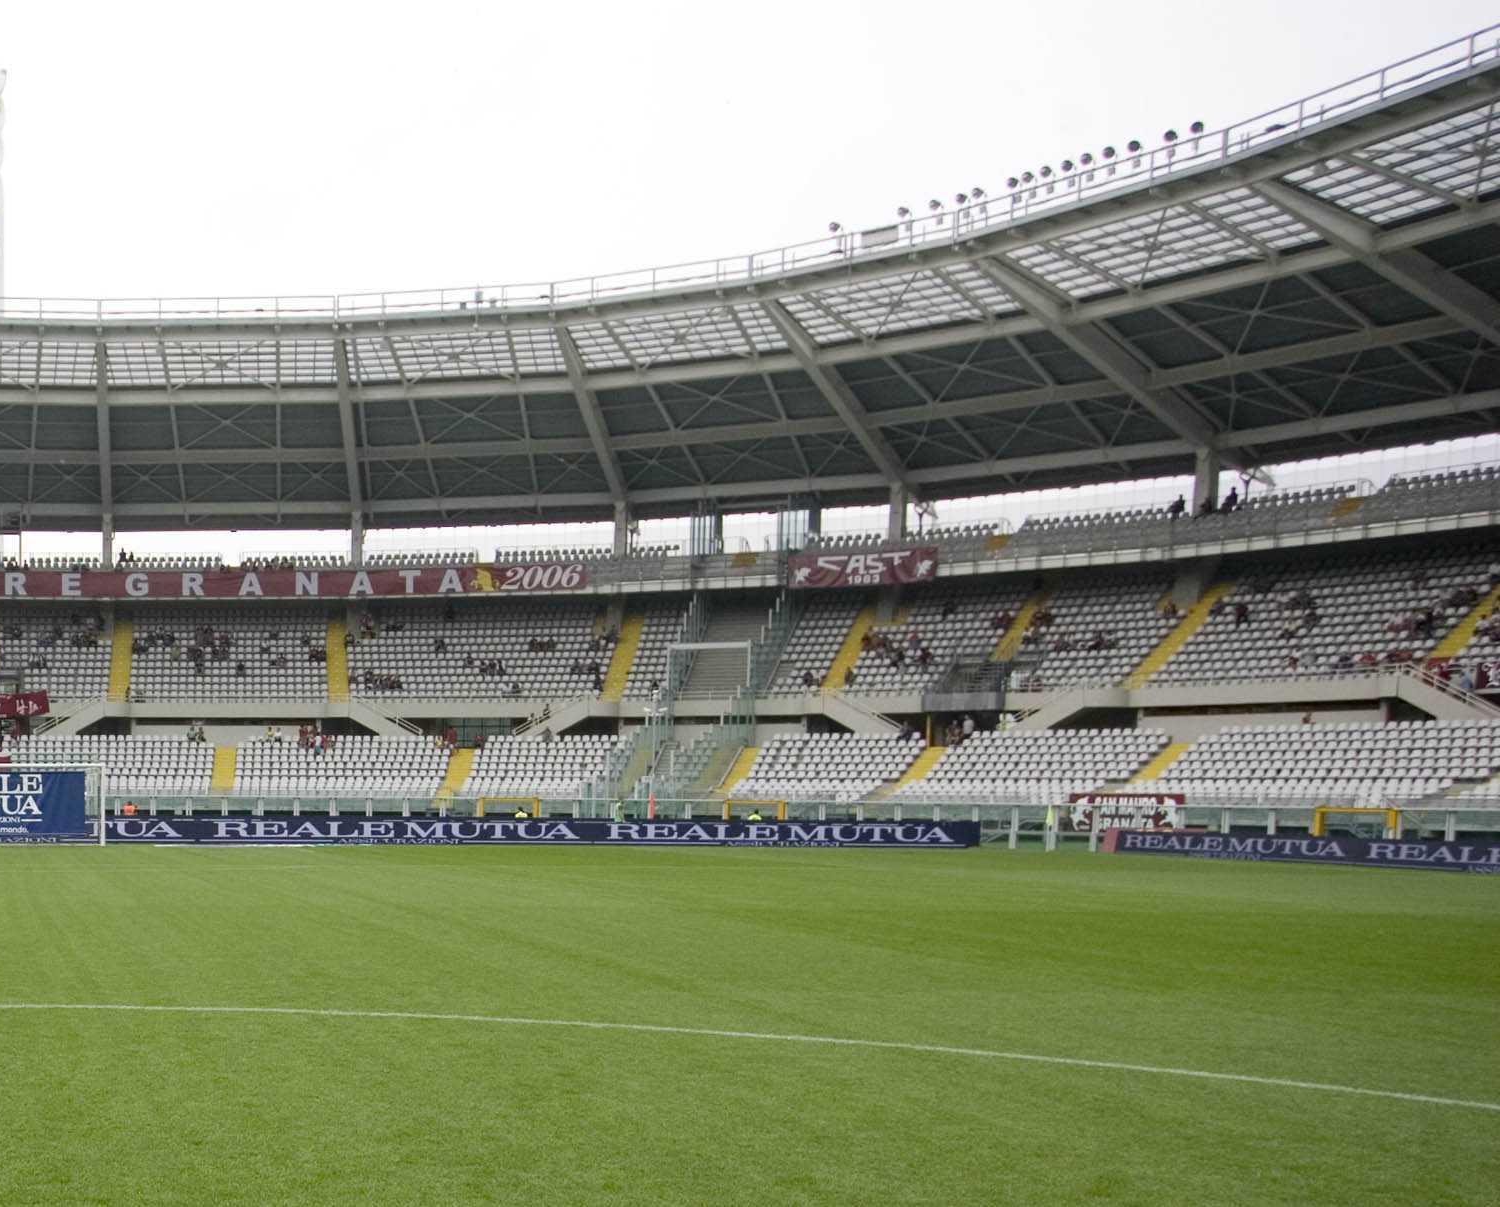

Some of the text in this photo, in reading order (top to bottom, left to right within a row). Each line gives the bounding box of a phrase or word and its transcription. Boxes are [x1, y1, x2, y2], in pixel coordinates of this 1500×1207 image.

[125, 569, 464, 597] GRANATA
[500, 563, 583, 591] 2006
[0, 825, 29, 834] mondo.
[212, 820, 396, 838] REALE
[404, 821, 580, 840] MUTUA
[606, 823, 955, 843] REALE MUTUA
[1124, 834, 1224, 852] REALE
[1227, 838, 1345, 857] MUTUA
